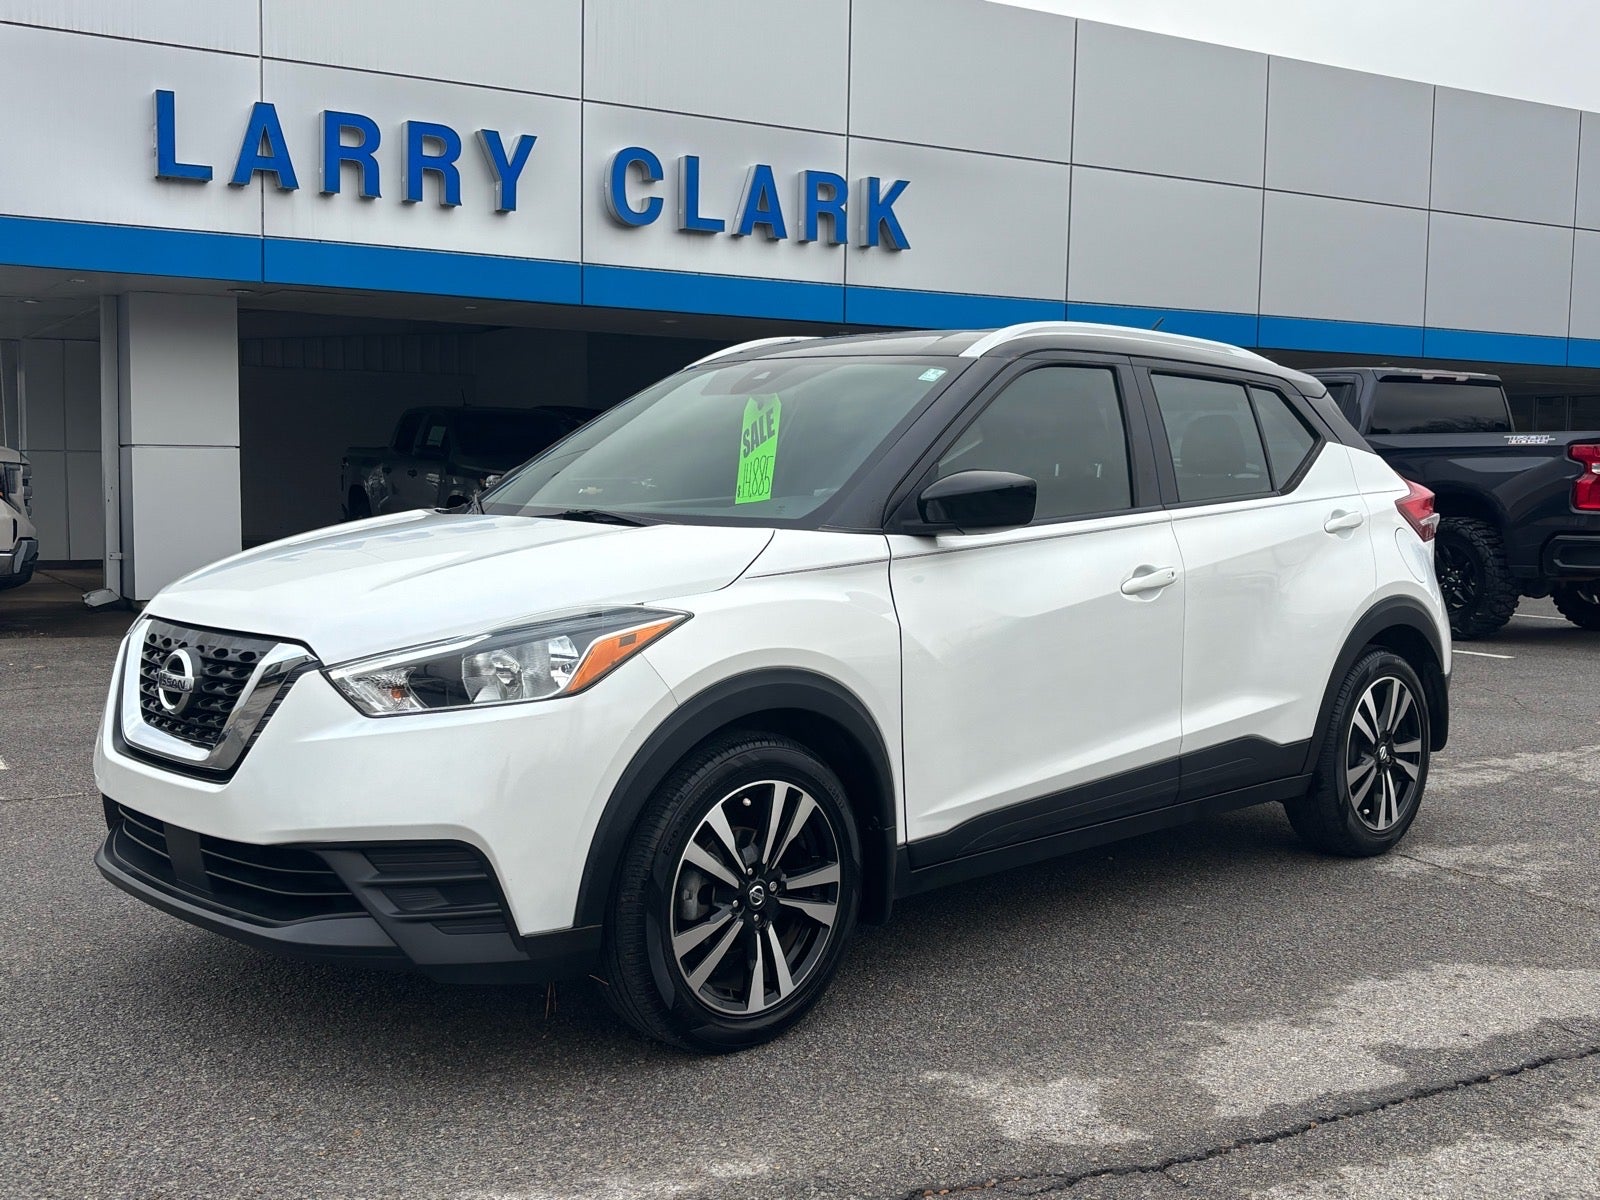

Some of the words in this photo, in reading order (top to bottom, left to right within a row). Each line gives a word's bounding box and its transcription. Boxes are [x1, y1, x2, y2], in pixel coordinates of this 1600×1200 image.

[155, 89, 537, 211] LARRY
[606, 147, 910, 251] CLARK
[743, 408, 775, 458] SALE
